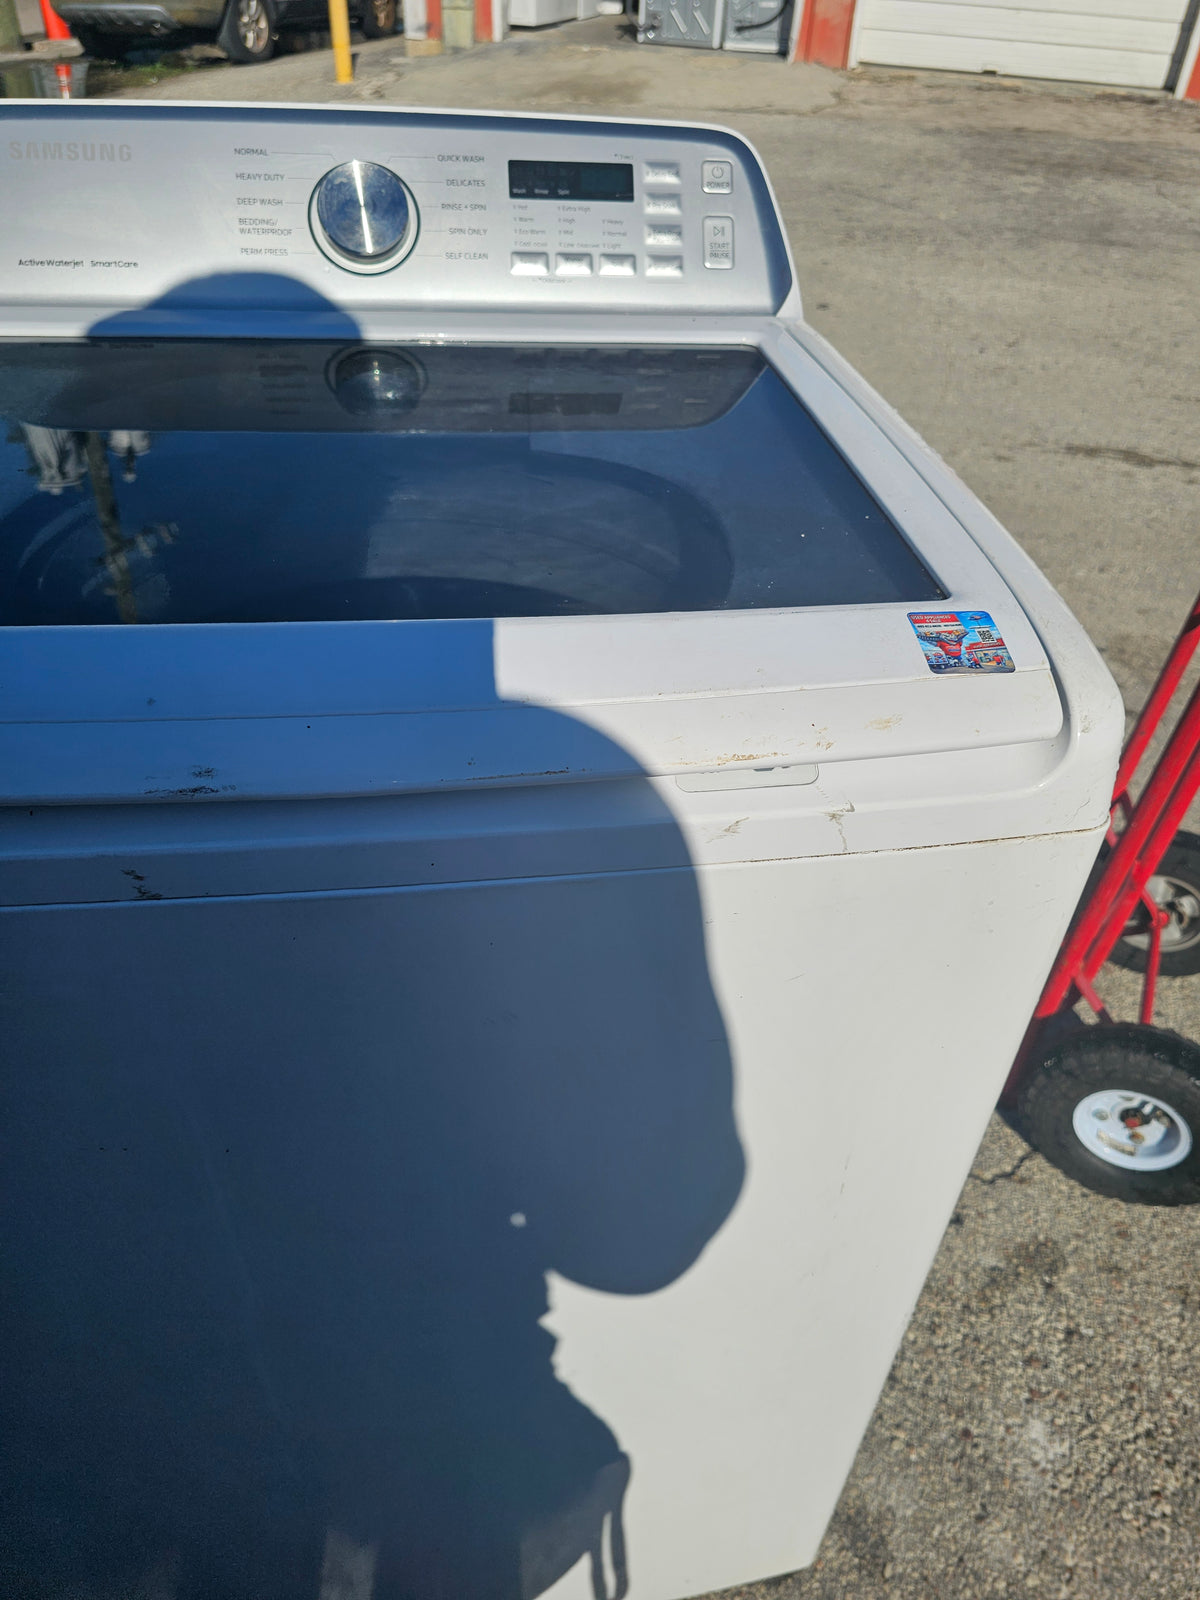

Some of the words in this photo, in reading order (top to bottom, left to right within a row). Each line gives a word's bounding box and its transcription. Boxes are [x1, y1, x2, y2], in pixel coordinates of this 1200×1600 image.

[9, 140, 132, 162] SAMSUNG
[234, 147, 269, 157] NORMAL
[437, 154, 461, 163] QUICK
[462, 155, 485, 164] WASH
[235, 172, 262, 181] HEAVY
[264, 173, 285, 181] DUTY
[446, 179, 486, 188] DELICATES
[706, 181, 730, 190] POWER
[236, 197, 259, 206] DEEP
[260, 198, 283, 207] WASH
[441, 202, 462, 211] RINSE
[470, 203, 487, 211] SPIN
[238, 217, 279, 226] BEDDING/
[239, 227, 293, 237] WATERPROOF
[448, 228, 466, 236] SPIN
[467, 228, 488, 237] ONLY
[709, 242, 730, 251] START
[240, 247, 263, 256] PERM
[264, 248, 289, 257] PRESS
[445, 252, 462, 260] SELF
[464, 253, 489, 261] CLEAN
[90, 260, 139, 269] SmartCare
